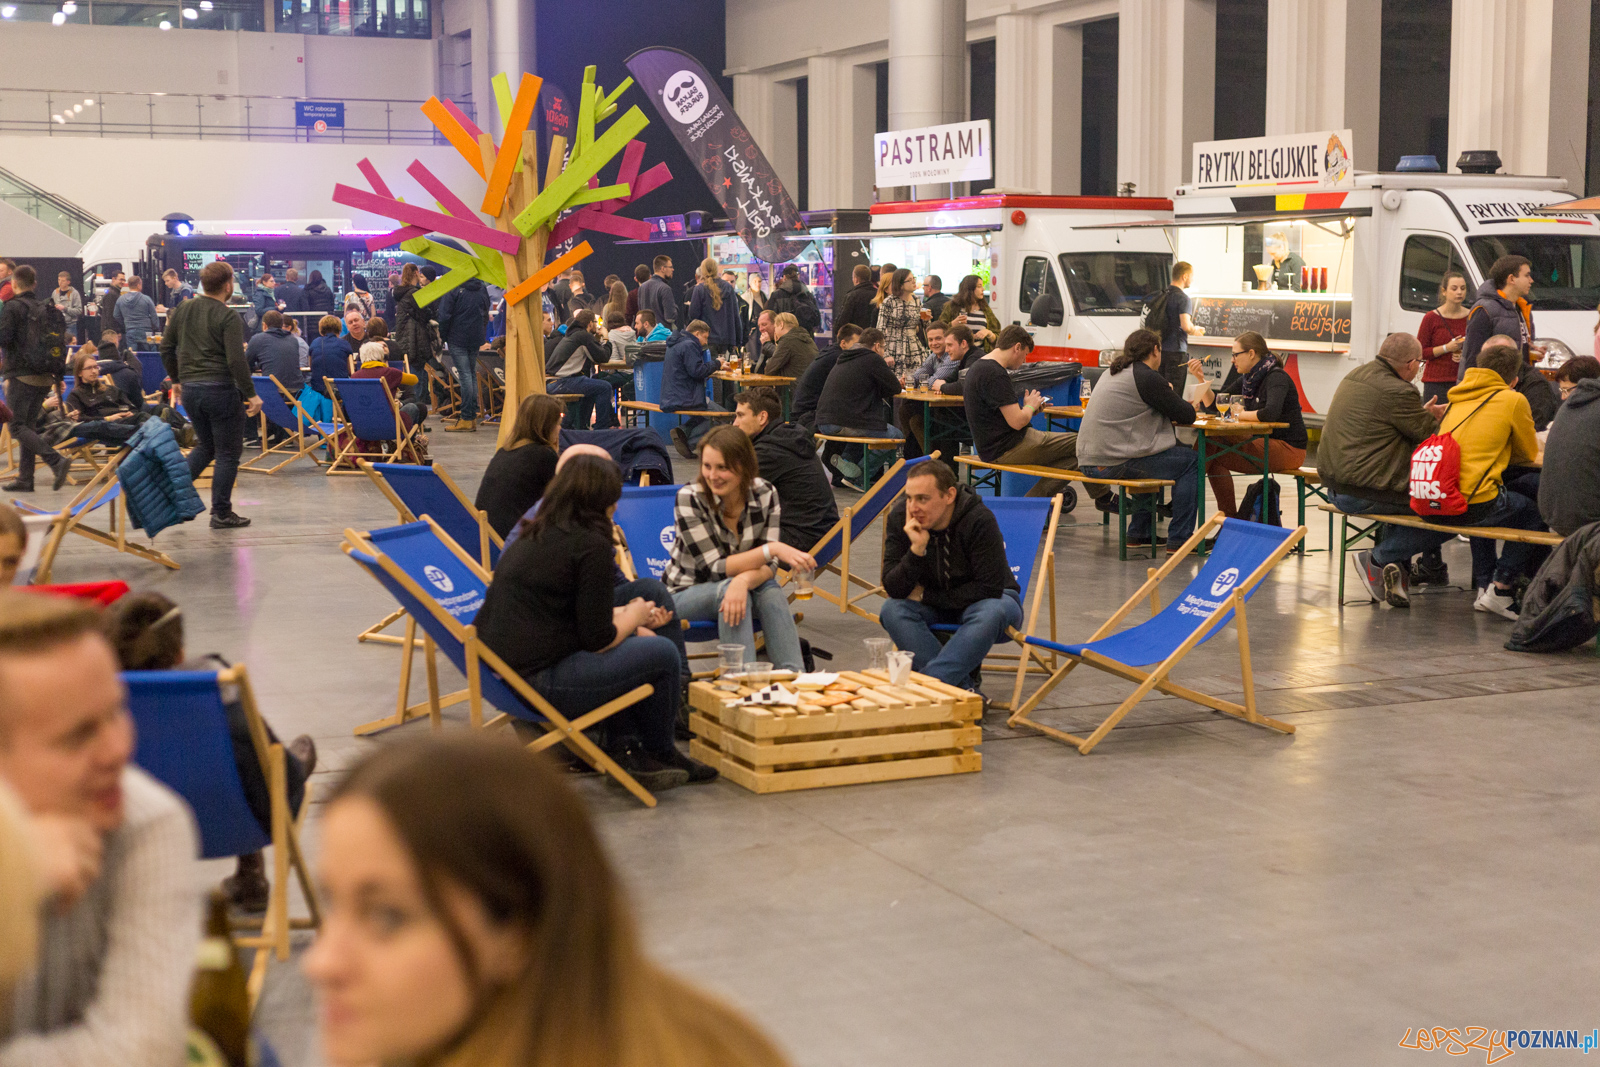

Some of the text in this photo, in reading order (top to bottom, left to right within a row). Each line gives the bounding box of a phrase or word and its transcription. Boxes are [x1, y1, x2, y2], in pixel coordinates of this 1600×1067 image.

[880, 128, 982, 166] PASTRAMI
[1198, 150, 1244, 184] FRYTKI
[1248, 145, 1318, 180] BELGIJSKIE
[1466, 202, 1520, 218] FRYTKI
[1294, 302, 1330, 317] FRYTKI
[1411, 462, 1438, 480] MY
